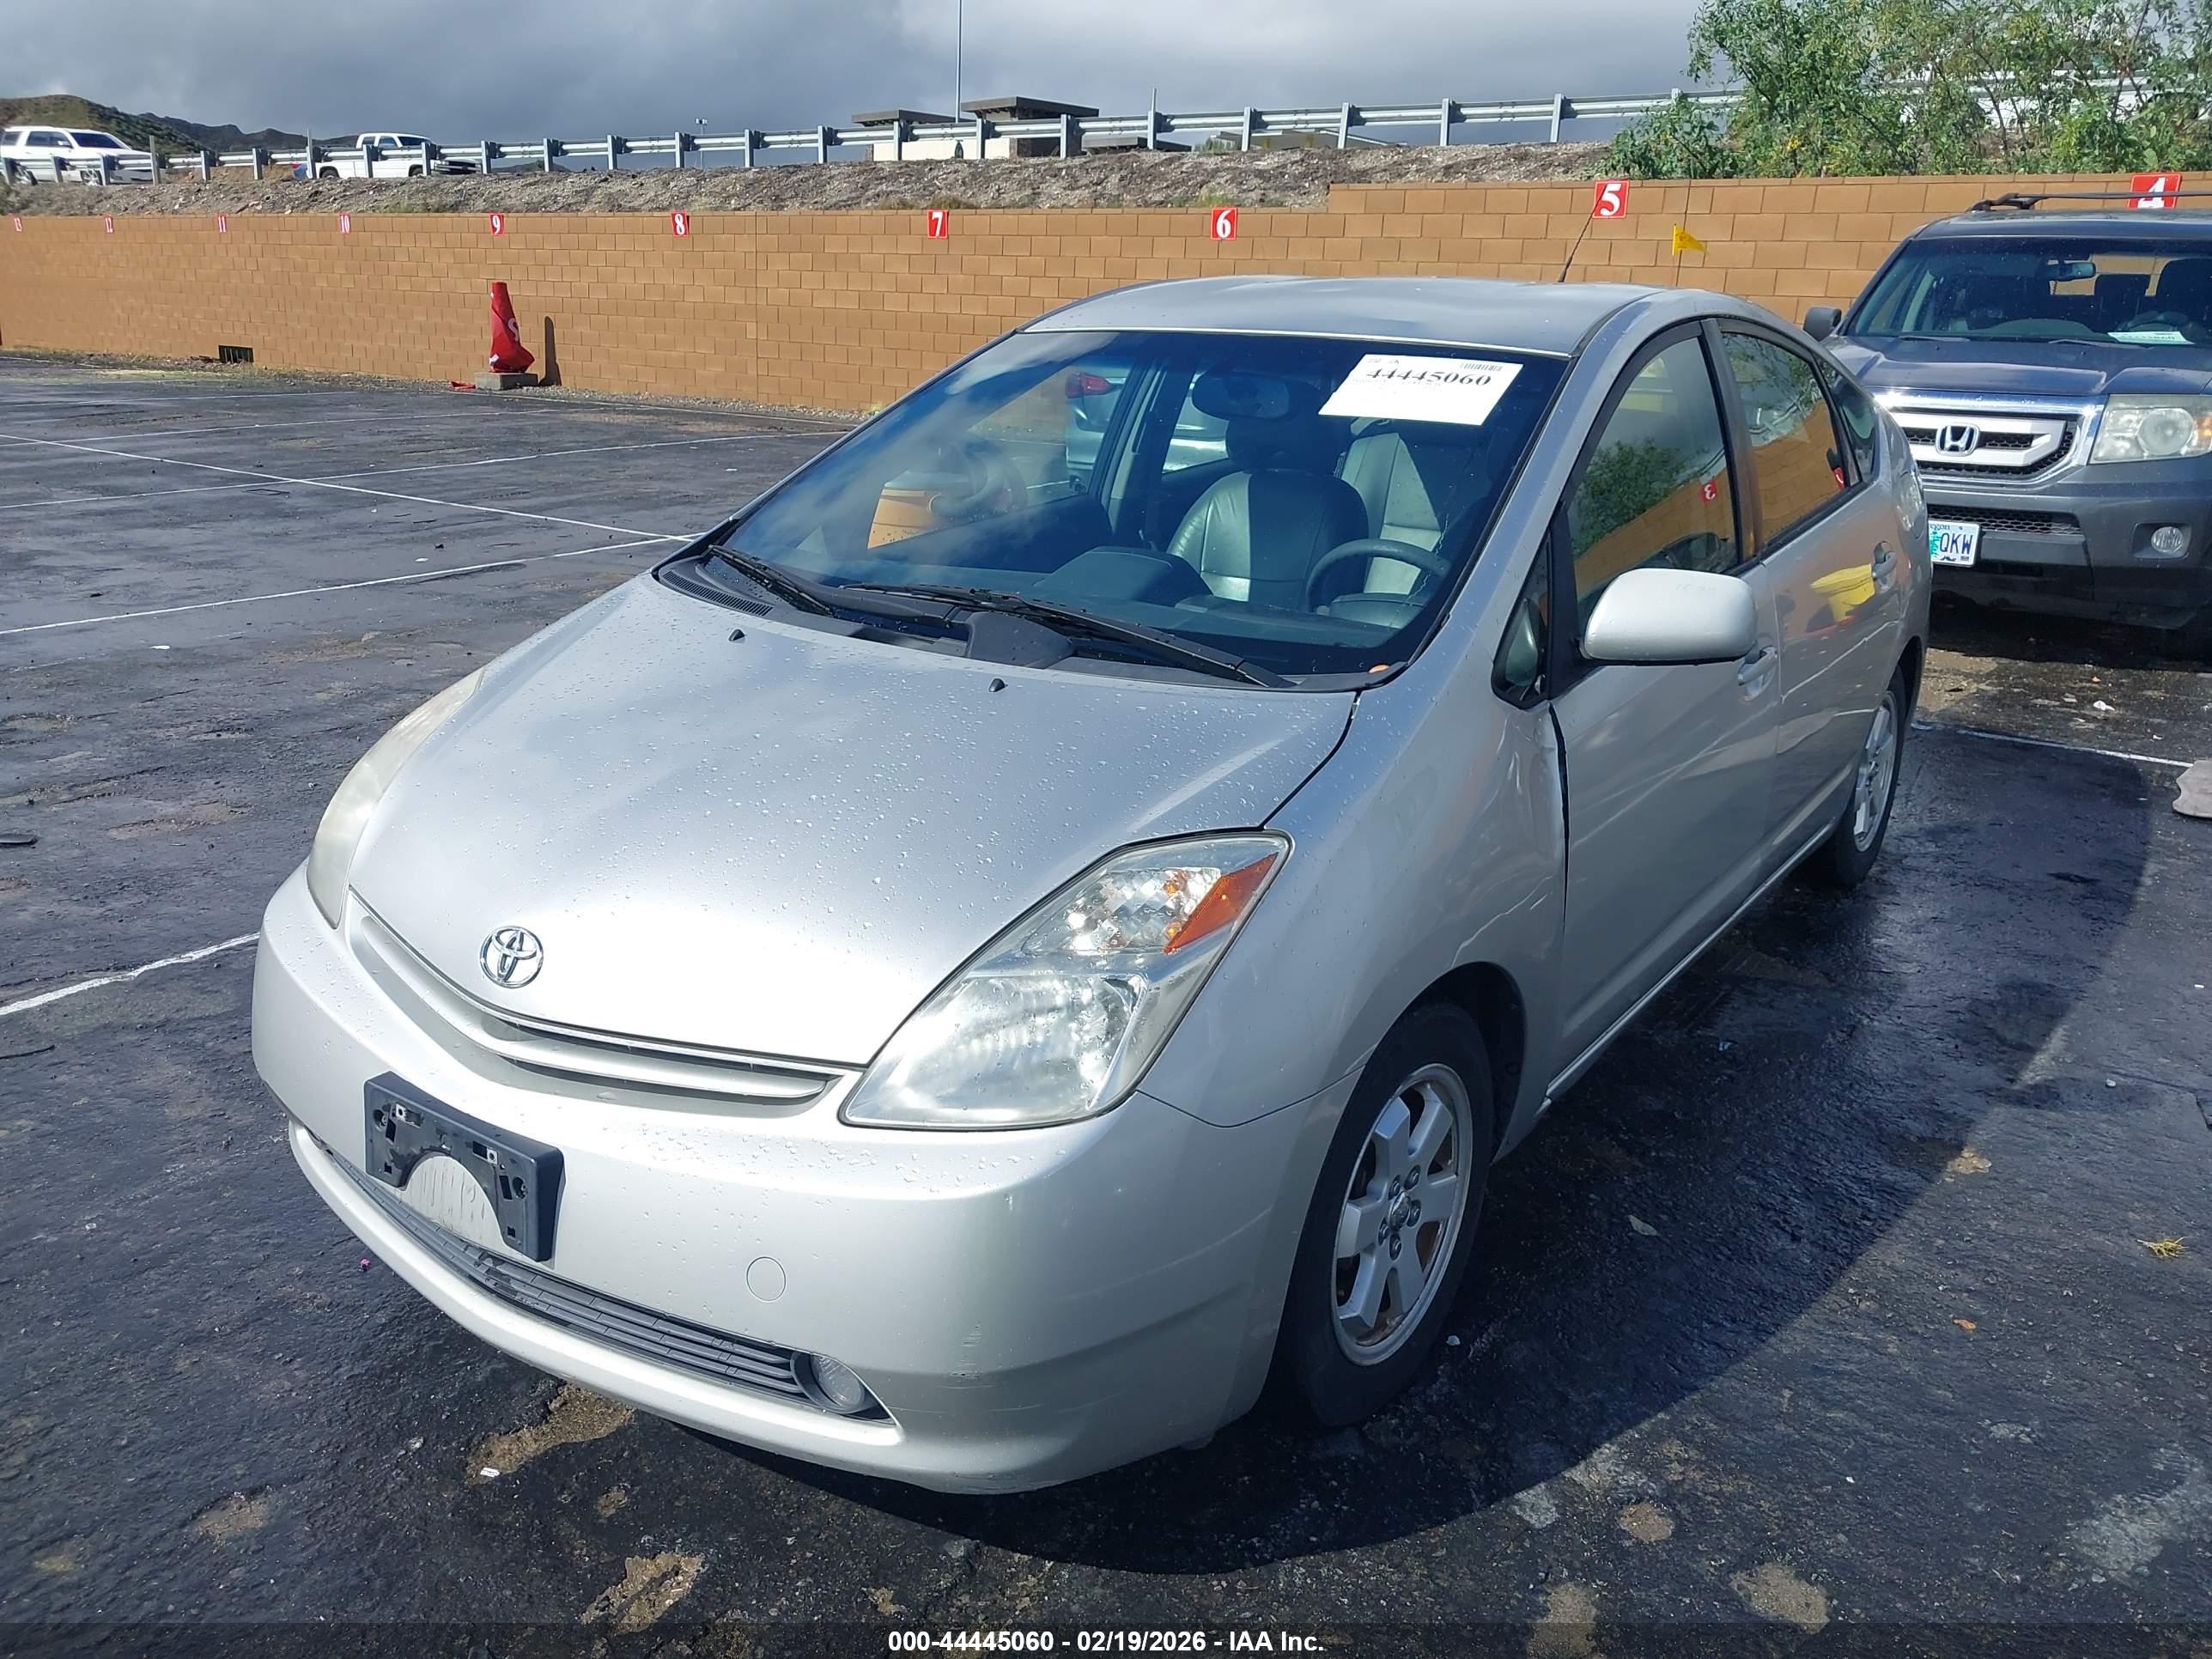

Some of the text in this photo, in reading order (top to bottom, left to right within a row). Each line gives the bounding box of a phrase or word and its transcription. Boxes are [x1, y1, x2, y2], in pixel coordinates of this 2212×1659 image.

[1600, 183, 1622, 216] 5
[2136, 176, 2166, 209] 4
[217, 215, 227, 233] 11
[340, 215, 350, 234] 10
[492, 215, 501, 234] 9
[674, 213, 685, 235] 8
[932, 211, 944, 237] 7
[1216, 210, 1231, 239] 6
[1366, 368, 1492, 386] 44445060
